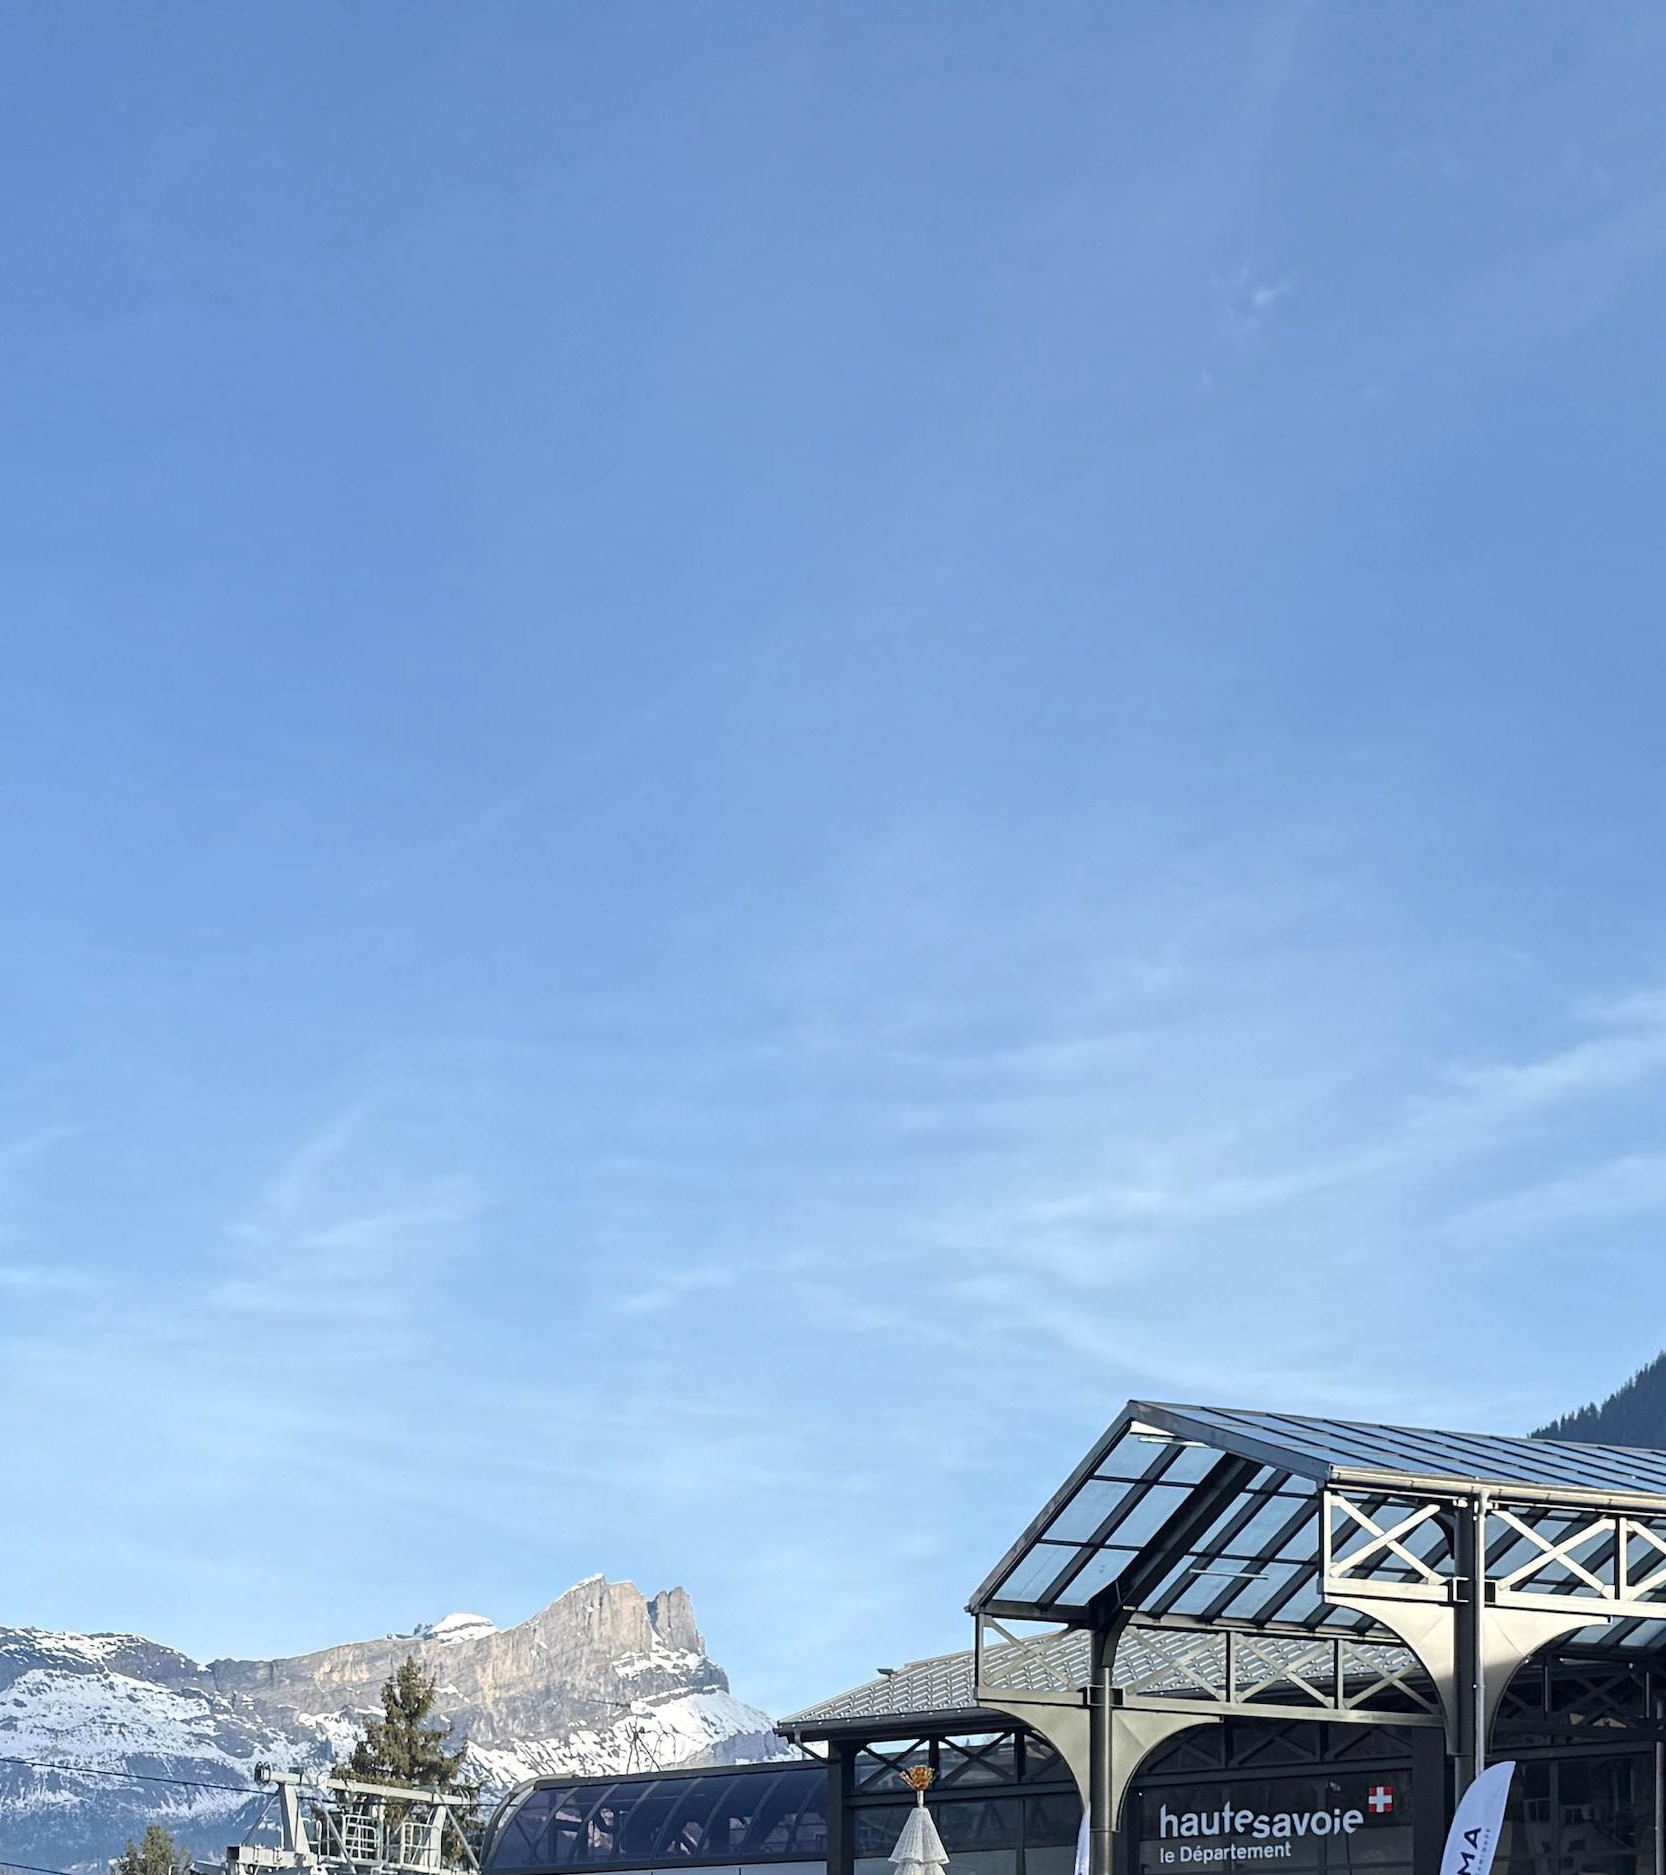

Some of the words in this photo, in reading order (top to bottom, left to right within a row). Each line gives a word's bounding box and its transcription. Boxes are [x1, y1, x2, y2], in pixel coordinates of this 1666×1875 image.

[1160, 1801, 1365, 1839] hautesavoie
[1160, 1848, 1175, 1864] le
[1180, 1841, 1292, 1865] Département
